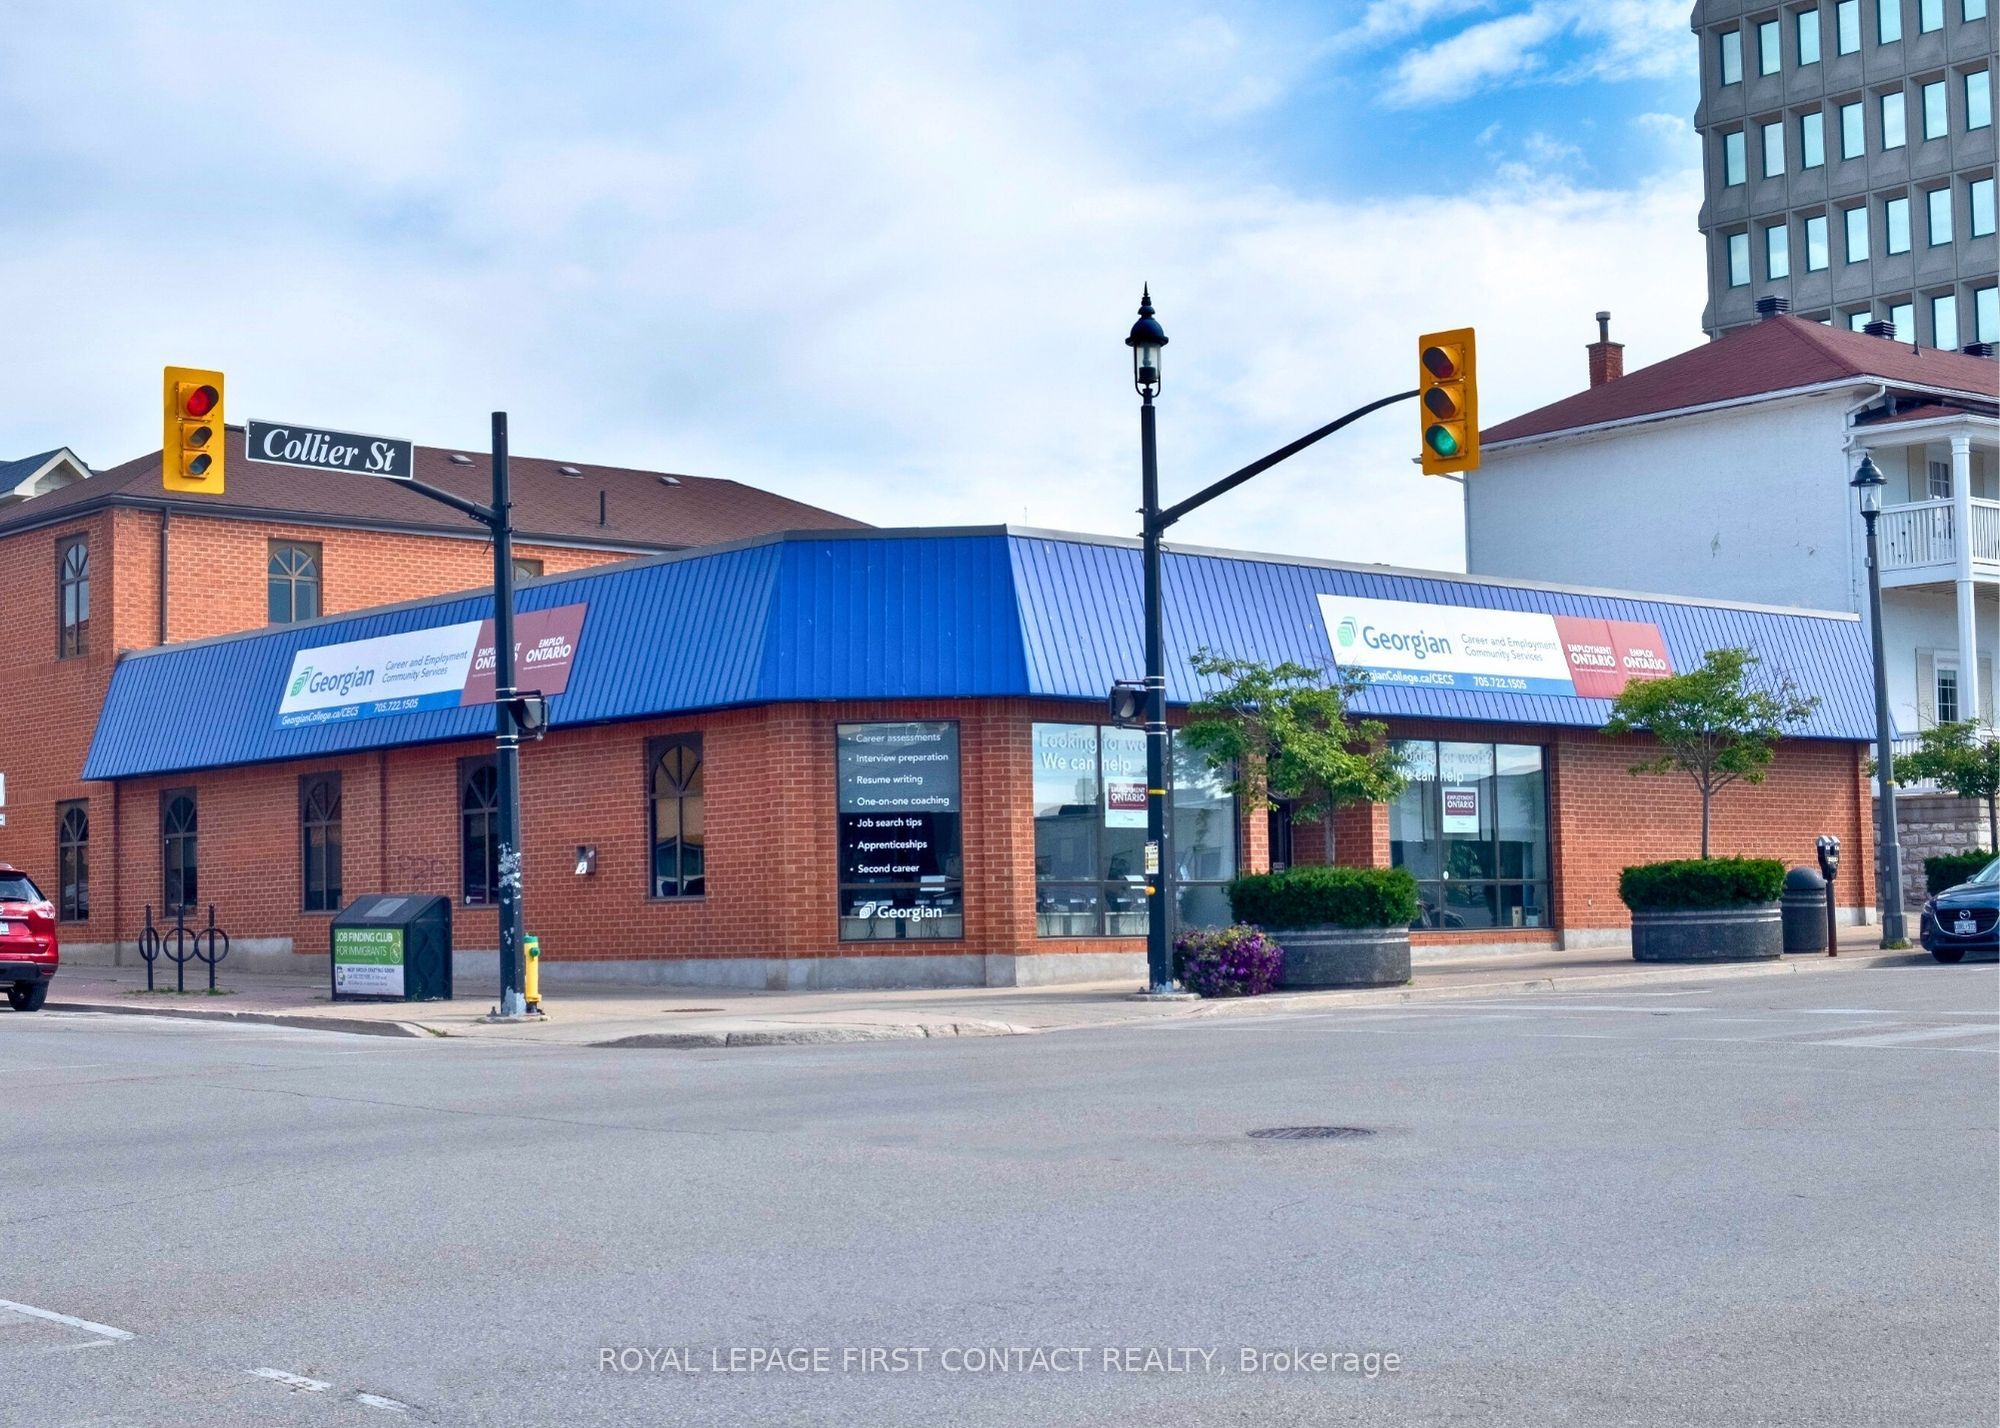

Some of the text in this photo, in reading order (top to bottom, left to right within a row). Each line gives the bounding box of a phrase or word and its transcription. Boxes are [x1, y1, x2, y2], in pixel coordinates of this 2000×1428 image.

[263, 428, 396, 472] Collier St
[538, 636, 565, 649] EMPLOI
[1363, 625, 1452, 660] Georgian
[1461, 633, 1558, 652] Career and Employment
[1567, 643, 1612, 656] EMPLOYMENT
[525, 644, 572, 663] ONTARIO
[1465, 646, 1543, 662] Community Services
[1571, 652, 1616, 668] ONTARIO
[1629, 648, 1654, 658] EMPLOI
[385, 651, 468, 671] Career and Employment
[1623, 656, 1666, 671] ONTARIO
[309, 665, 375, 697] Georgian
[382, 666, 449, 684] Community Services
[1473, 675, 1528, 690] 705.722.1505
[282, 697, 420, 726] GeorgianCollege.ca/CECS 705.722.1505
[856, 733, 942, 743] Career assessments
[1040, 731, 1098, 755] Looking
[856, 752, 949, 764] Interview preparation
[1041, 752, 1132, 777] We can help
[856, 774, 924, 786] Resume writing
[1415, 769, 1436, 783] can
[1440, 767, 1465, 788] help
[857, 795, 950, 807] One-on-one coaching
[1110, 793, 1146, 803] ONTARIO
[1447, 800, 1475, 809] ONTARIO
[857, 817, 923, 829] Job search tips
[857, 840, 928, 853] Apprenticeships
[857, 863, 920, 874] Second career
[877, 905, 943, 923] Georgian
[336, 932, 393, 943] JOB FINDING CLUB
[337, 945, 348, 956] FOR
